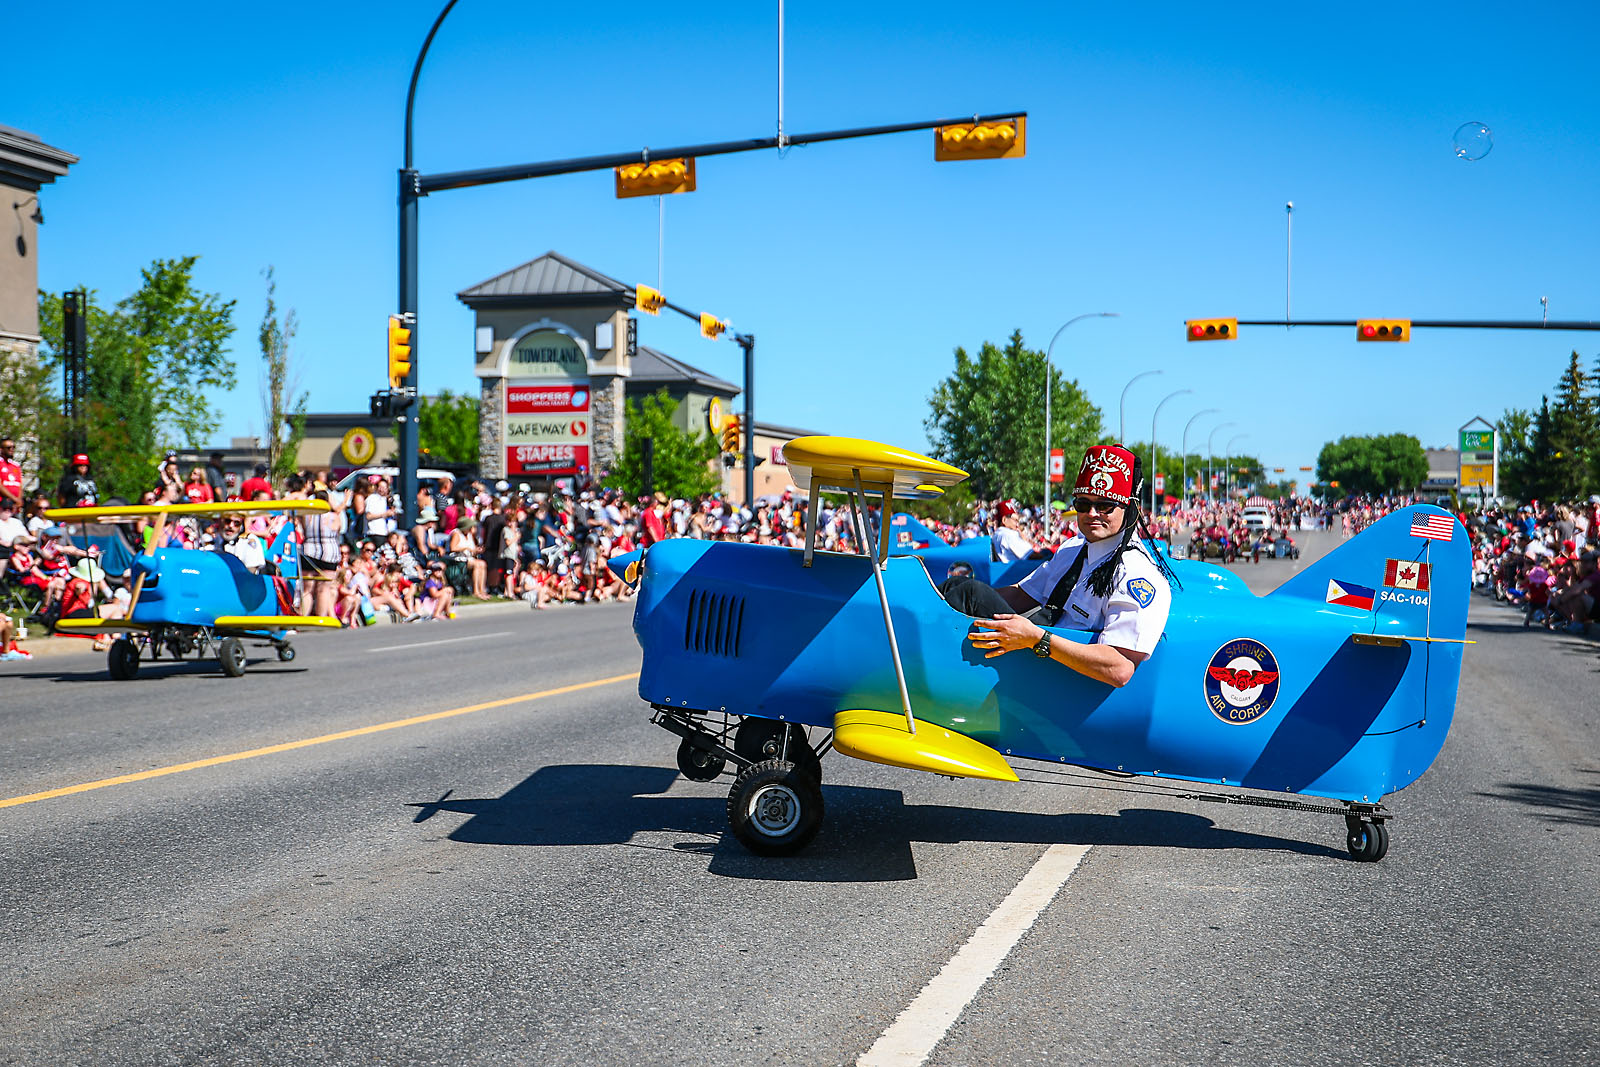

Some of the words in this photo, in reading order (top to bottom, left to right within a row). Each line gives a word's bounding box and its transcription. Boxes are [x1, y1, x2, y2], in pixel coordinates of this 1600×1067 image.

[509, 392, 570, 401] SHOPPERS
[508, 423, 567, 436] SAFEWAY
[516, 446, 574, 462] STAPLES
[1080, 454, 1096, 474] AL
[1097, 448, 1131, 482] AZHAR
[1090, 489, 1105, 497] AIR
[1106, 491, 1130, 505] CORPS
[1380, 591, 1428, 606] SAC-104
[1225, 643, 1267, 662] SHRINE
[1230, 694, 1252, 702] CALGARY
[1210, 694, 1226, 713] AIR
[1229, 697, 1269, 720] CORPS
